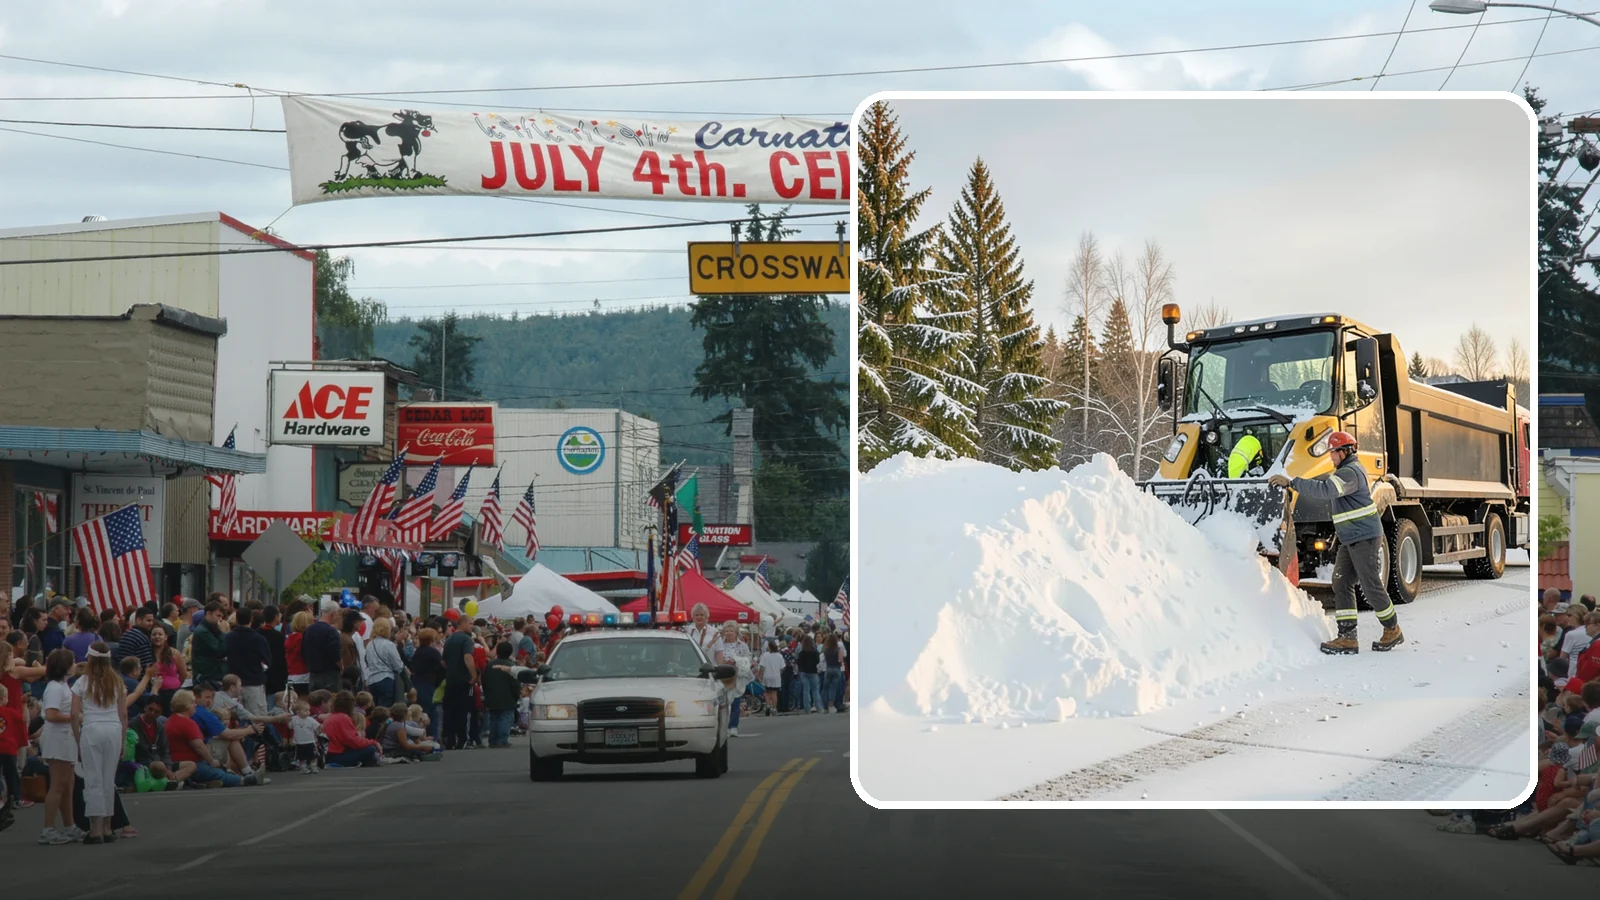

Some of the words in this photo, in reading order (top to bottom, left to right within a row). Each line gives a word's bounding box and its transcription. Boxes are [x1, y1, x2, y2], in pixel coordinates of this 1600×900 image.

[481, 140, 604, 193] JULY
[632, 150, 746, 198] 4th.
[697, 254, 850, 280] CROSSWA
[283, 380, 373, 420] ACE
[405, 409, 452, 422] CEDAR
[283, 421, 371, 436] Hardware
[416, 428, 477, 447] Coca-Cola
[83, 485, 93, 494] St.
[95, 485, 124, 494] Vincent
[126, 485, 136, 495] de
[137, 486, 155, 495] Paul
[81, 503, 154, 522] THT
[212, 516, 331, 535] HARDARE
[688, 526, 741, 535] CRNATION
[699, 535, 730, 543] GLASS
